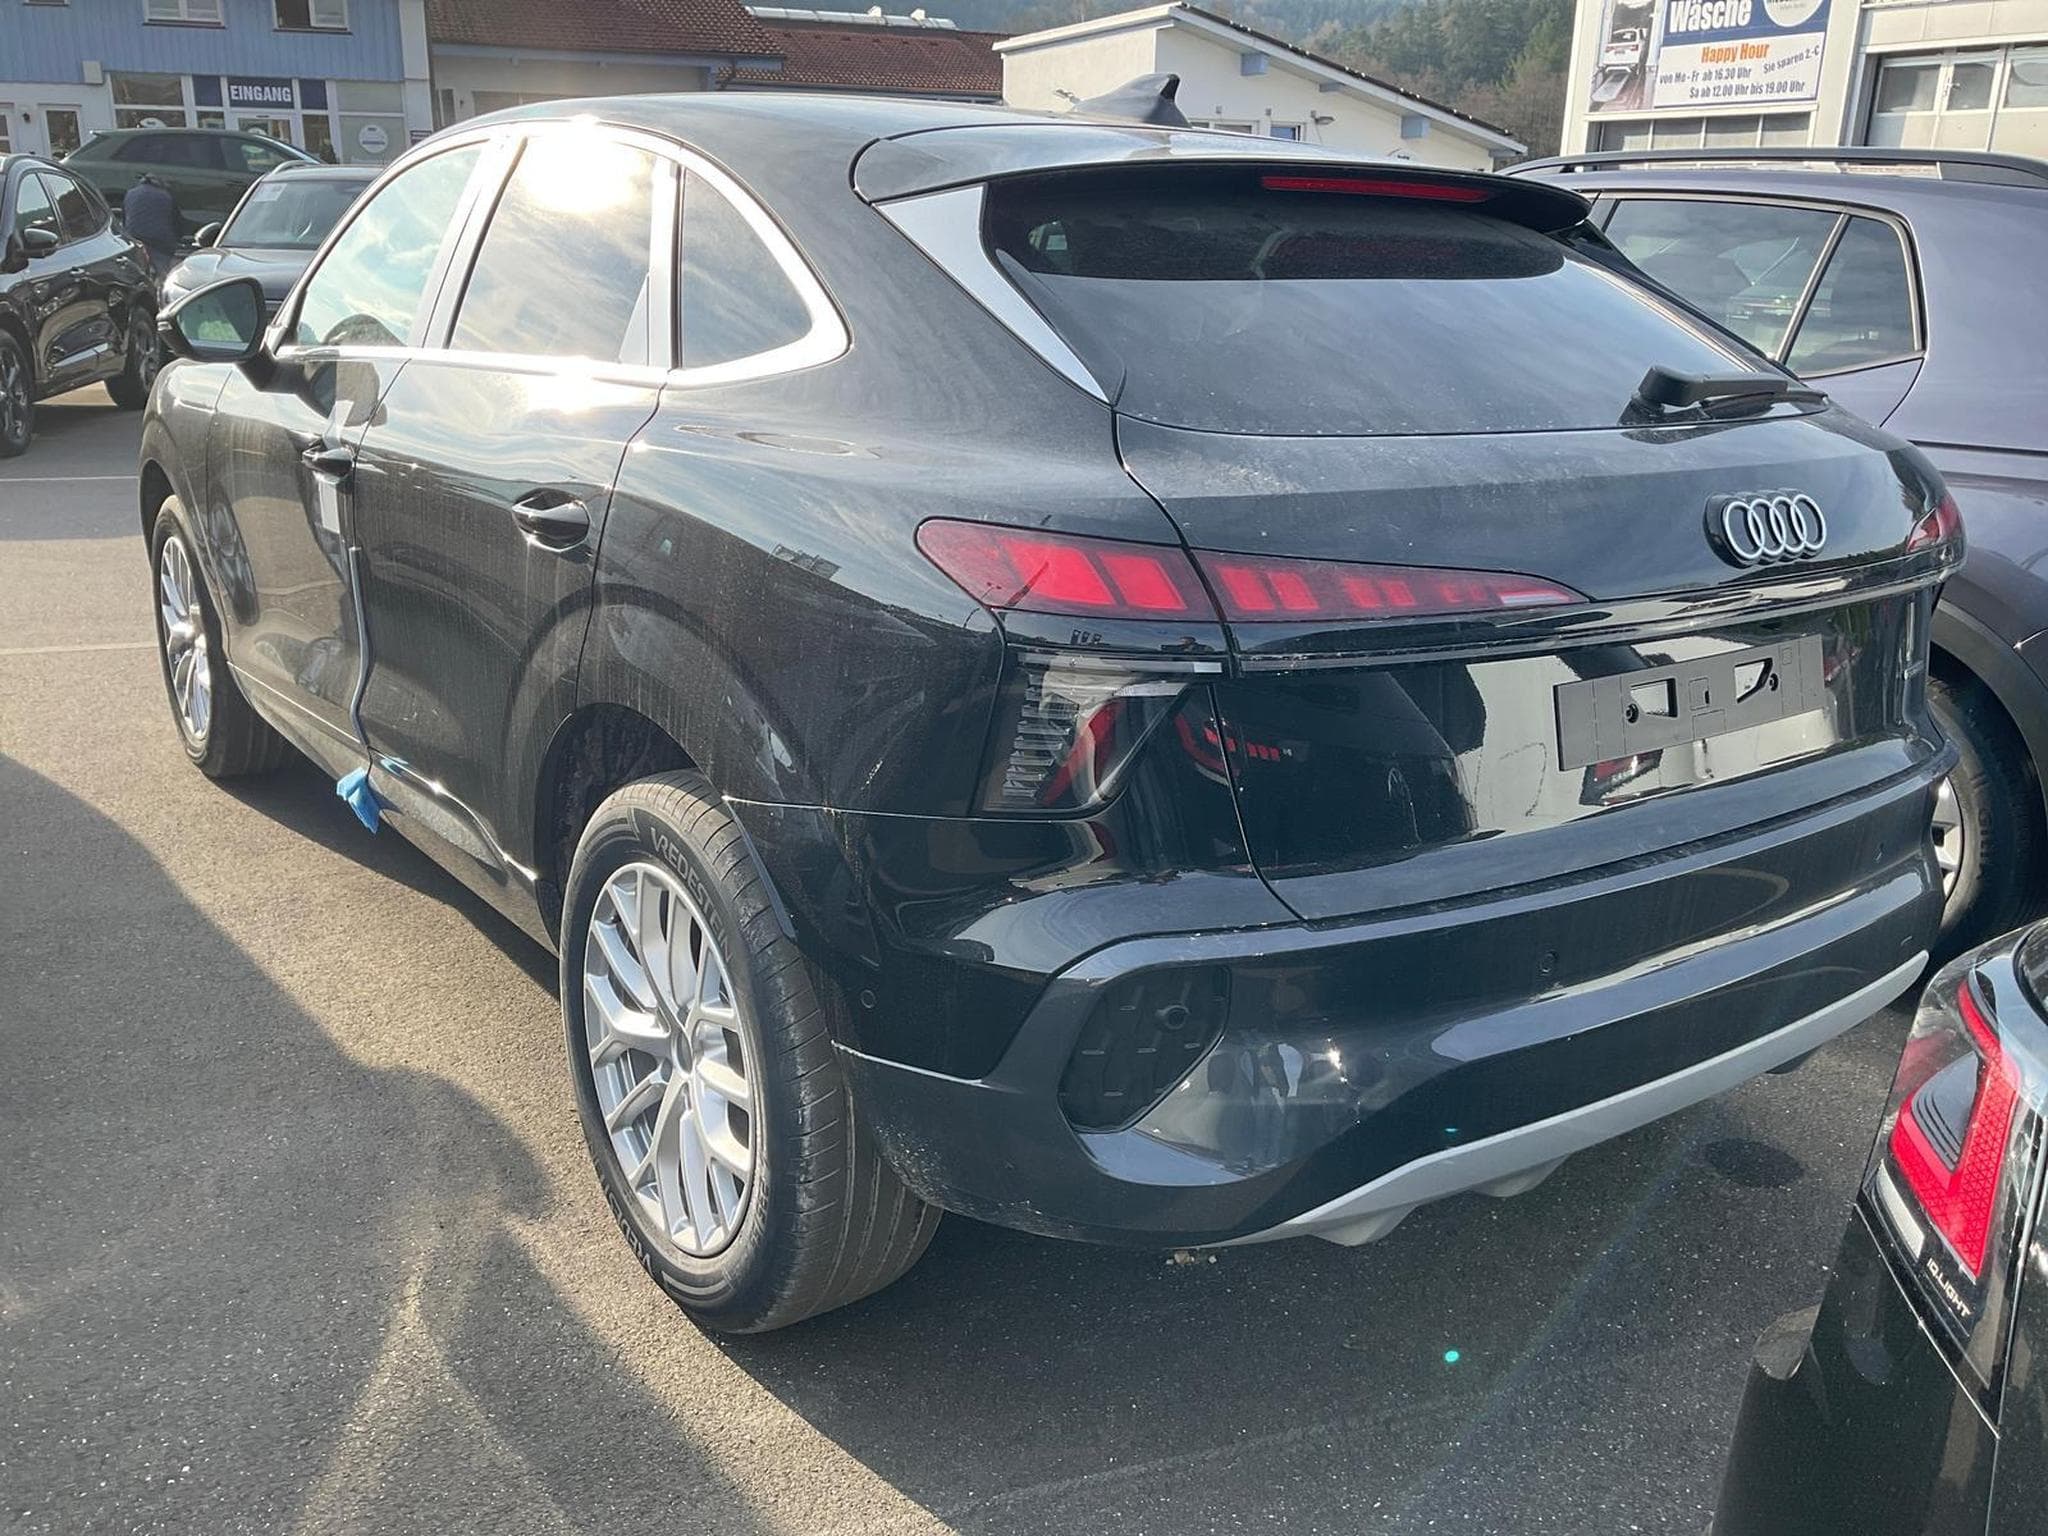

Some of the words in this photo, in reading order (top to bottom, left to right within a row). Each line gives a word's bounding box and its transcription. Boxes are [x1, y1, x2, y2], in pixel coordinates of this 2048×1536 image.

[1669, 0, 1752, 33] Wäsche
[1701, 46, 1738, 64] Happy
[1740, 43, 1770, 60] Hour
[1763, 63, 1776, 74] Sie
[1777, 52, 1804, 69] sparen
[1660, 73, 1673, 84] von
[1675, 72, 1686, 83] Mo
[1692, 70, 1700, 82] Fr
[1702, 69, 1713, 81] ab
[1737, 67, 1752, 79] Uhr
[229, 84, 292, 102] EINGANG
[1690, 87, 1700, 98] Sa
[1701, 86, 1711, 97] ab
[1713, 84, 1733, 97] 12.00
[1735, 84, 1749, 95] Uhr
[1750, 82, 1764, 95] bis
[1765, 80, 1788, 94] 19.00
[1789, 80, 1805, 93] Uhr
[651, 826, 732, 963] VREDESTEIN
[1927, 1258, 1971, 1317] IQ.LIGHT
